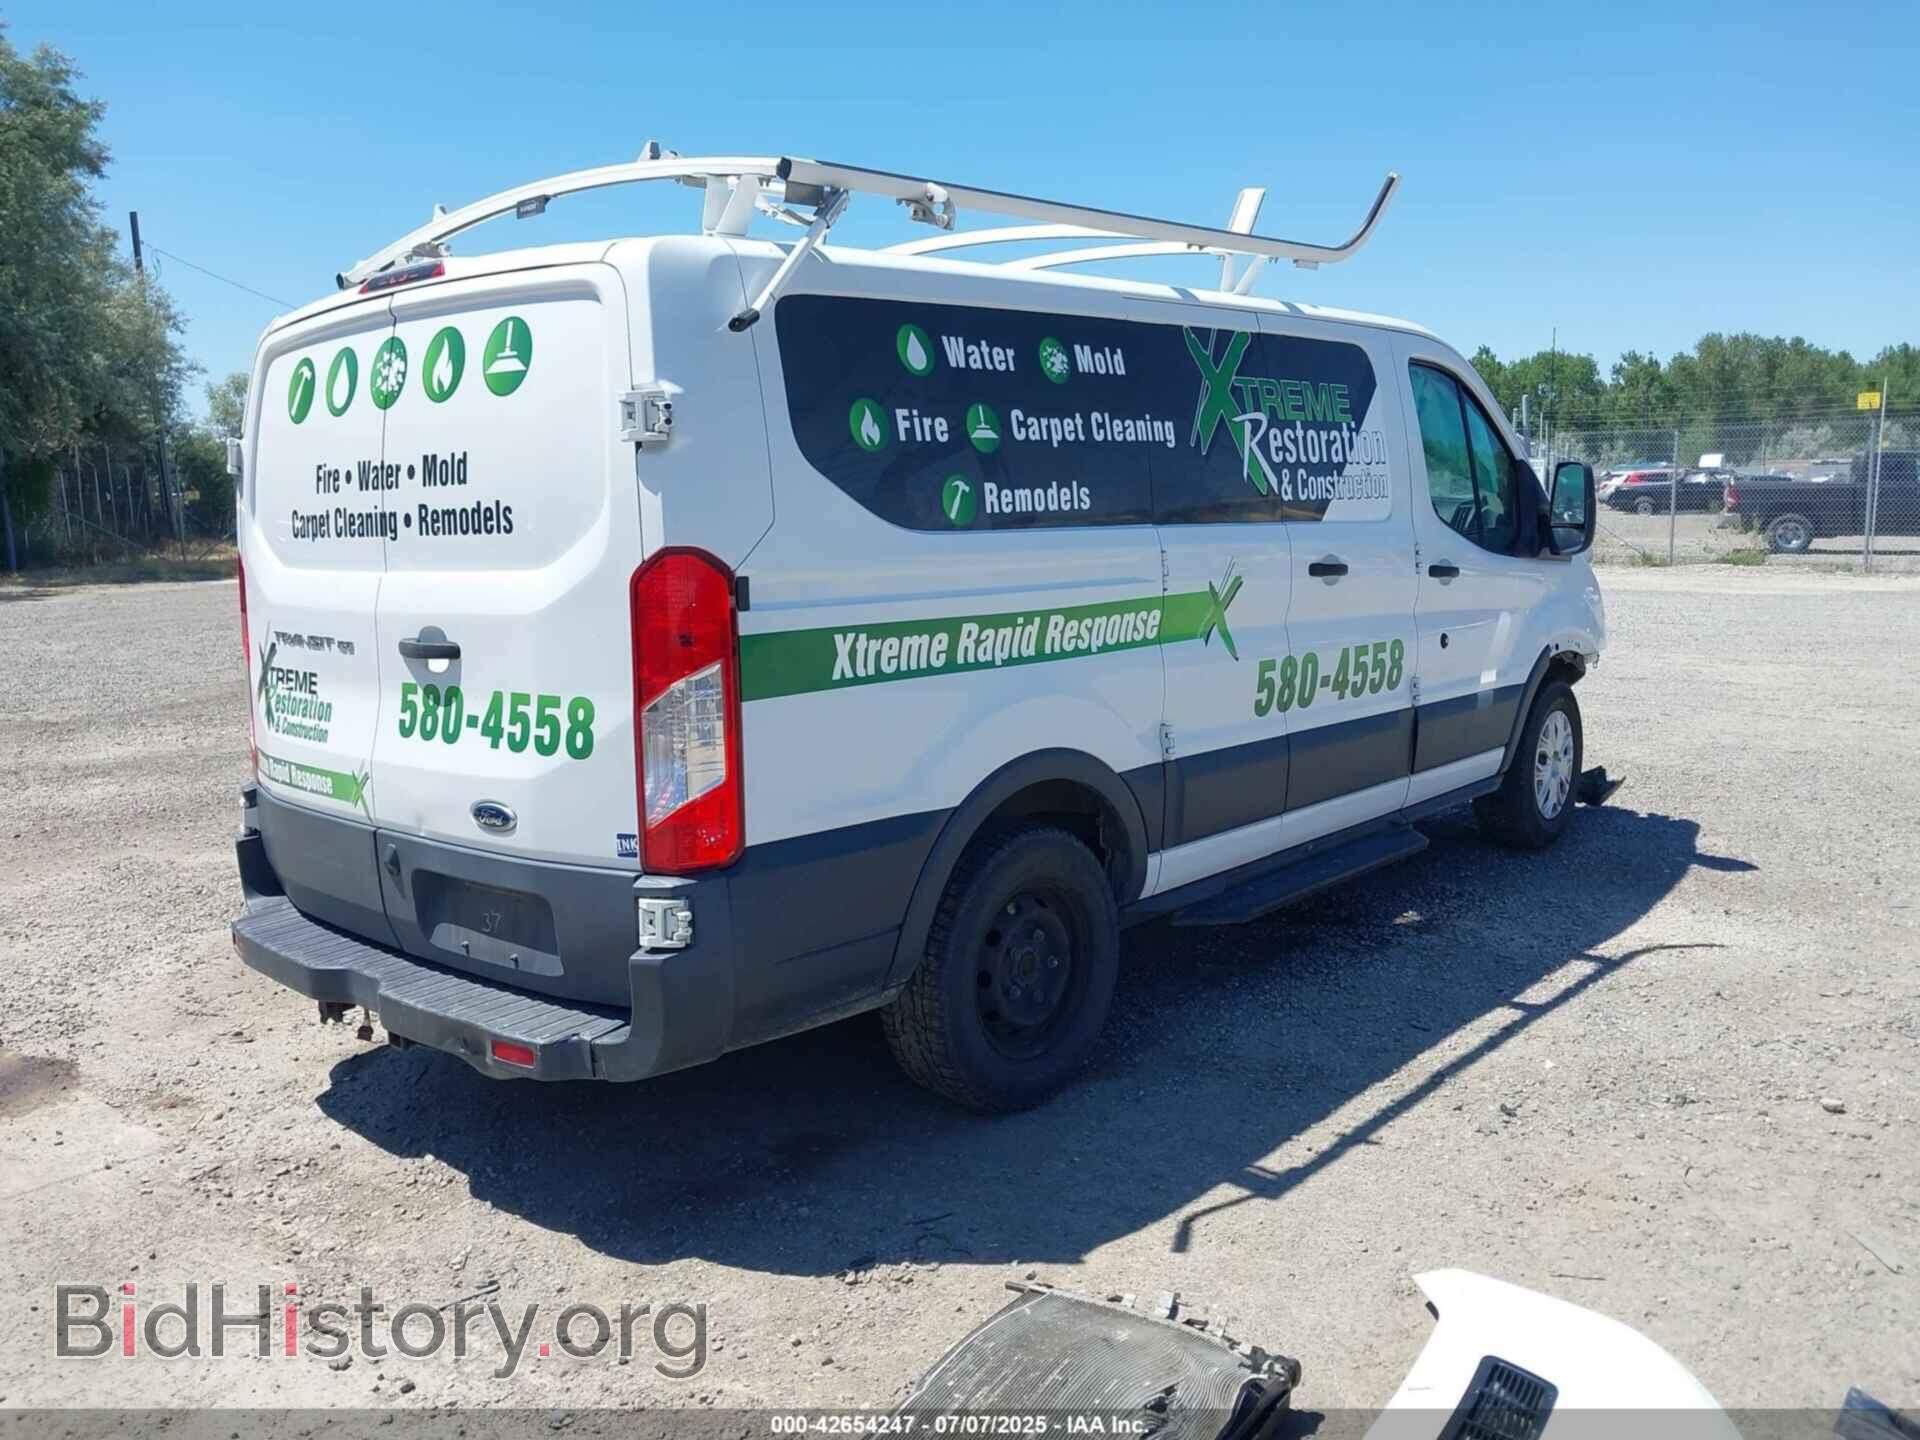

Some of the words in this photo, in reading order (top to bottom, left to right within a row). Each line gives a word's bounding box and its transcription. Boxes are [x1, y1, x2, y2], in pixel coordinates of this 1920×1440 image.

[941, 335, 1016, 372] Water
[1073, 344, 1126, 376] Mold
[895, 408, 949, 443] Fire
[1010, 408, 1085, 448] Carpet
[1090, 412, 1176, 448] Cleaning
[1183, 325, 1351, 496] XTREME
[316, 463, 340, 494] Fire
[357, 460, 401, 491] Water
[422, 452, 467, 487] Mold
[1231, 411, 1387, 495] Restoration
[984, 481, 1091, 514] Remodels
[1281, 468, 1294, 501] &
[1297, 466, 1389, 501] Construction
[292, 509, 331, 542] Carpet
[334, 504, 398, 541] Cleaning
[418, 500, 514, 537] Remodels
[832, 621, 948, 681] Xtreme
[956, 615, 1041, 668] Rapid
[1046, 608, 1161, 654] Response
[1254, 638, 1405, 718] 580-4558
[399, 681, 595, 760] 580-4558
[480, 808, 506, 826] Ford
